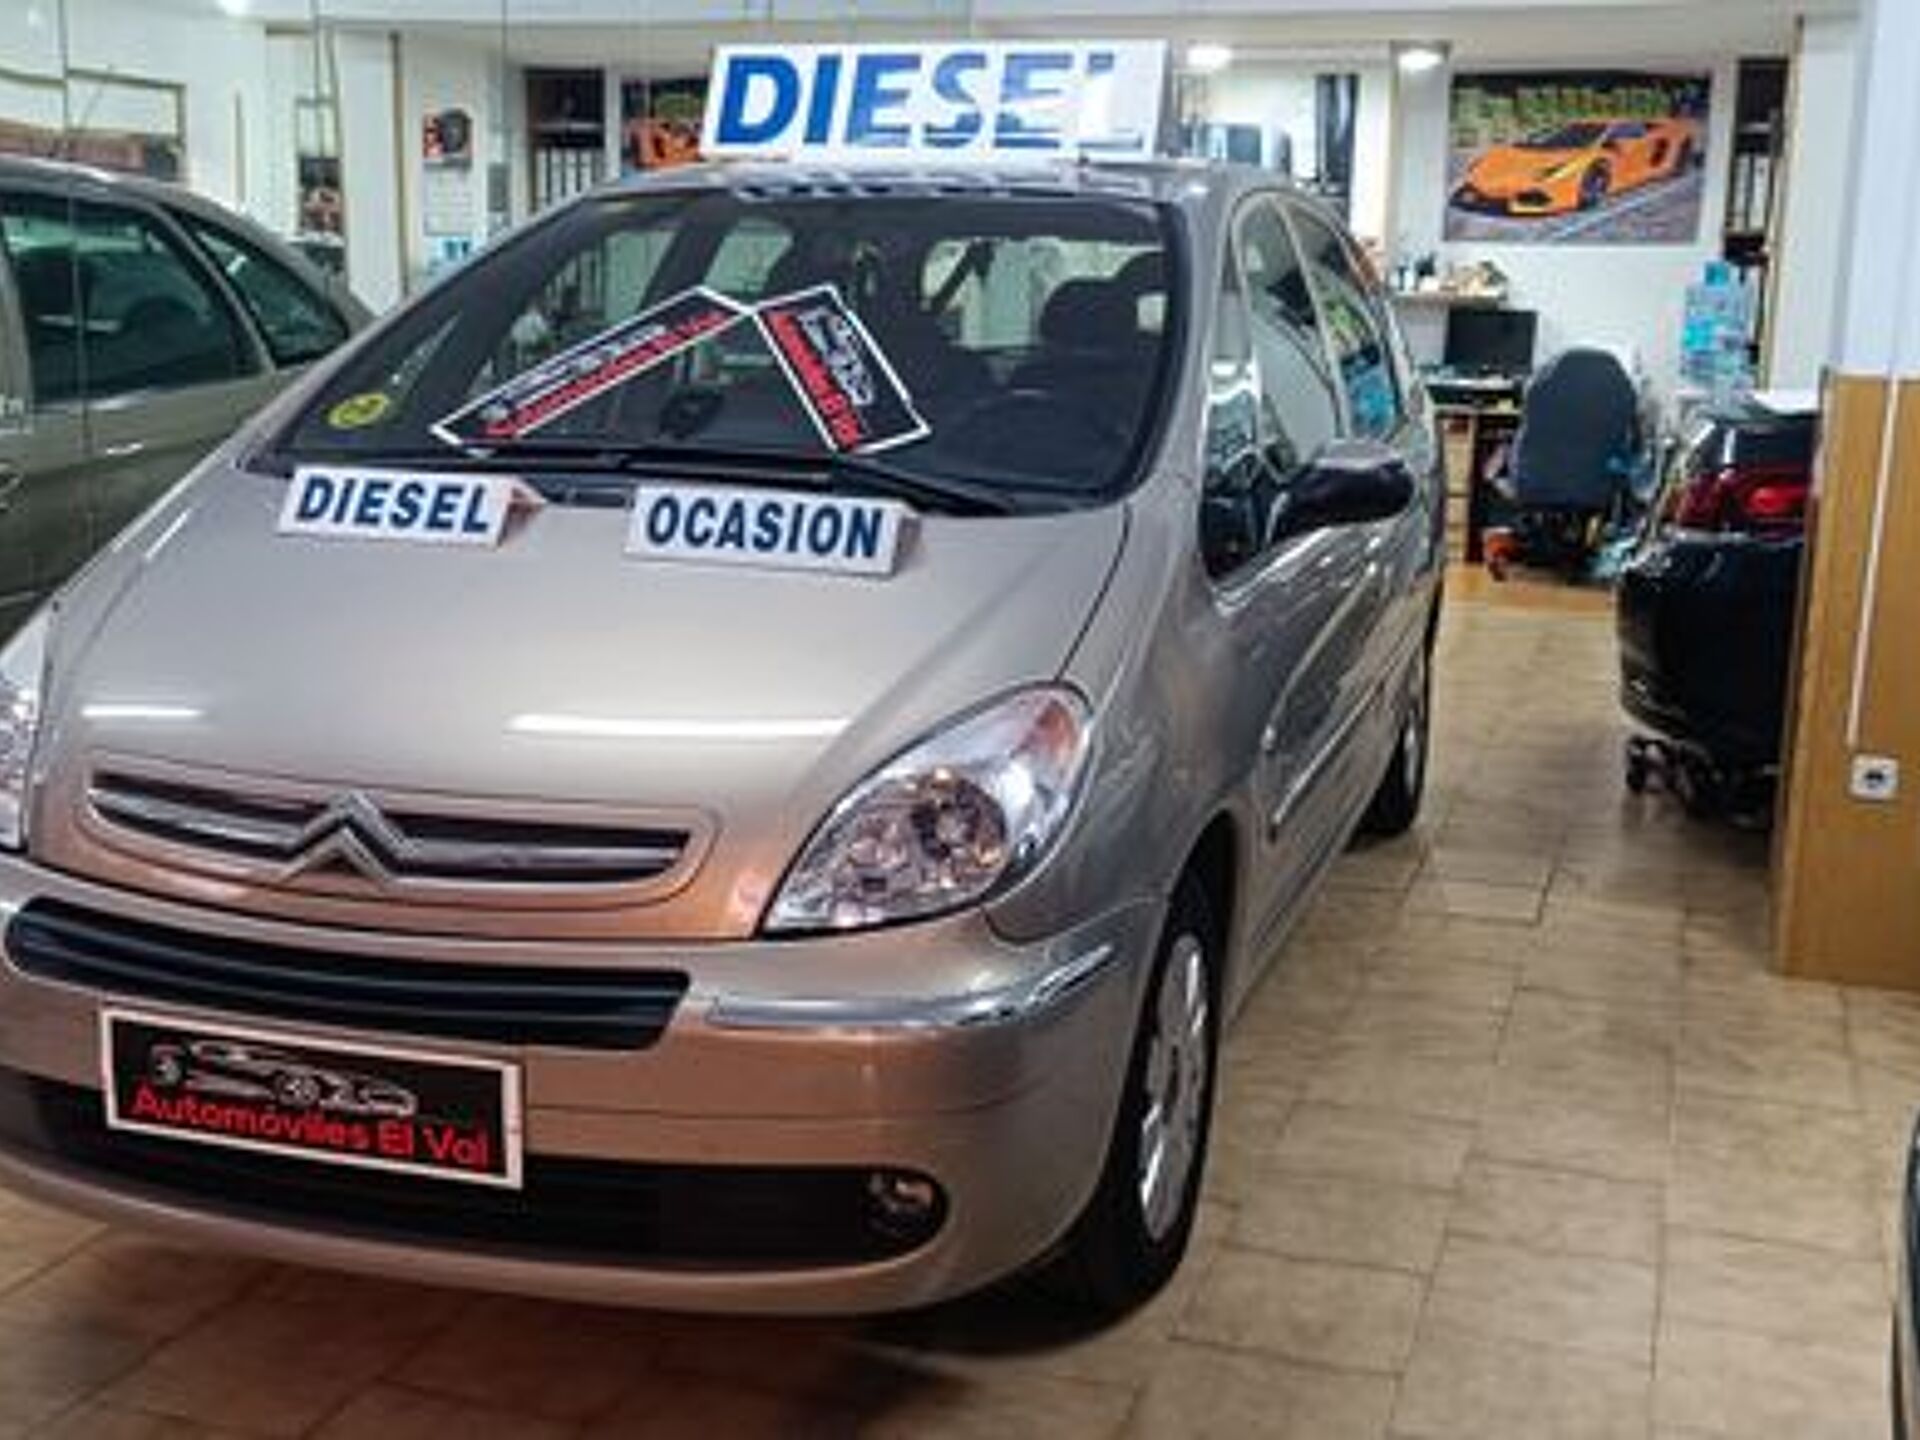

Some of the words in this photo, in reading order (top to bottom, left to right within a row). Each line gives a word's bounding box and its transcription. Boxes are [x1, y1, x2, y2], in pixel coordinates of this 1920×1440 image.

[714, 51, 1143, 149] DIESEL
[295, 475, 491, 534] DIESEL
[646, 495, 884, 558] OCASION
[378, 1119, 414, 1156] El
